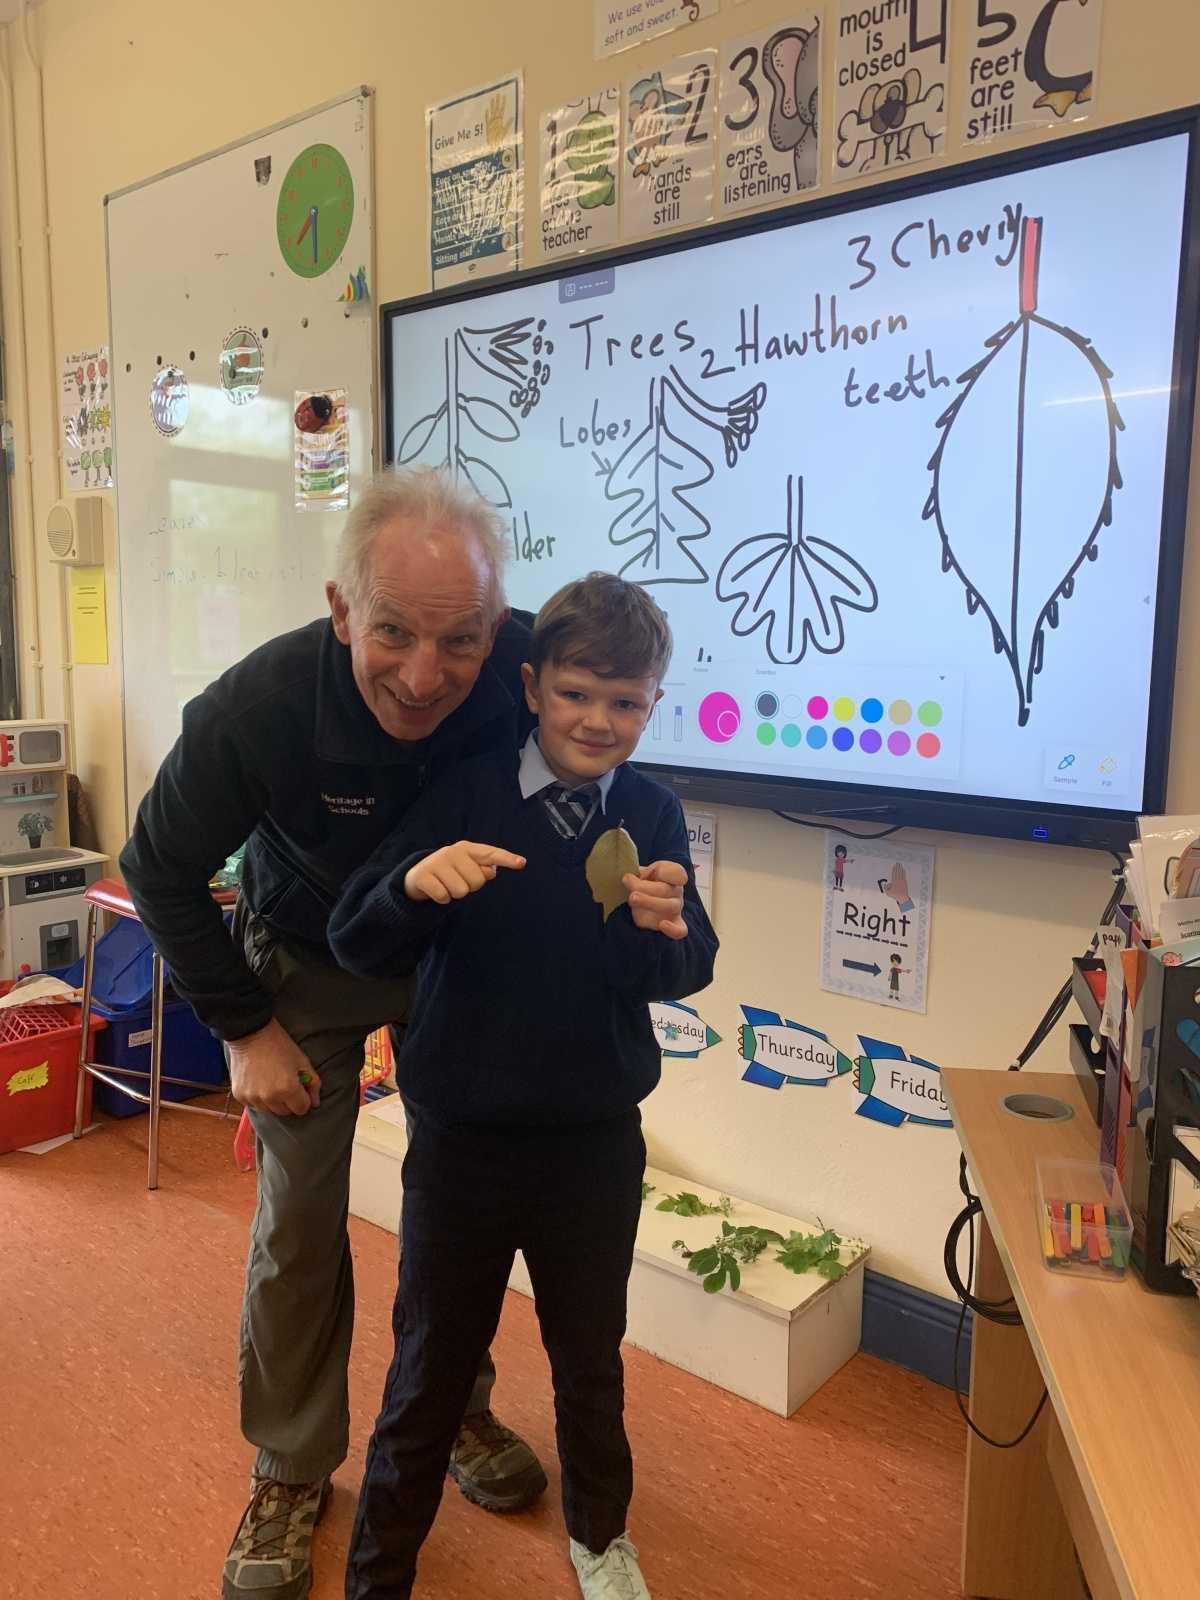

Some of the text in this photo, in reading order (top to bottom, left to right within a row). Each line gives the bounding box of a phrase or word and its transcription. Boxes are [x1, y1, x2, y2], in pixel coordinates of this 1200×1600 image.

[608, 9, 623, 24] We
[626, 3, 642, 17] use
[840, 0, 908, 37] mouth
[976, 0, 1016, 48] 5
[604, 30, 624, 46] soft
[627, 18, 645, 36] and
[865, 30, 883, 54] is
[909, 0, 947, 64] 4
[838, 42, 906, 87] closed
[969, 48, 1022, 84] feet
[685, 63, 710, 144] 2
[724, 46, 760, 131] 3
[970, 79, 1015, 108] are
[434, 135, 455, 151] Give
[457, 126, 472, 141] Me
[966, 104, 1013, 139] still
[726, 145, 763, 168] ears
[739, 160, 768, 181] are
[654, 187, 681, 204] are
[724, 172, 791, 204] listening
[653, 203, 680, 225] still
[542, 225, 593, 251] teacher
[848, 235, 877, 290] 3
[569, 314, 695, 370] Trees
[700, 292, 908, 379] 2 Hawthorn
[844, 348, 951, 408] teeth
[559, 398, 632, 449] Lobes
[513, 510, 556, 562] lder
[688, 825, 712, 845] ple
[844, 902, 911, 938] Right
[757, 1033, 836, 1072] Thursday
[890, 1071, 948, 1110] Friday
